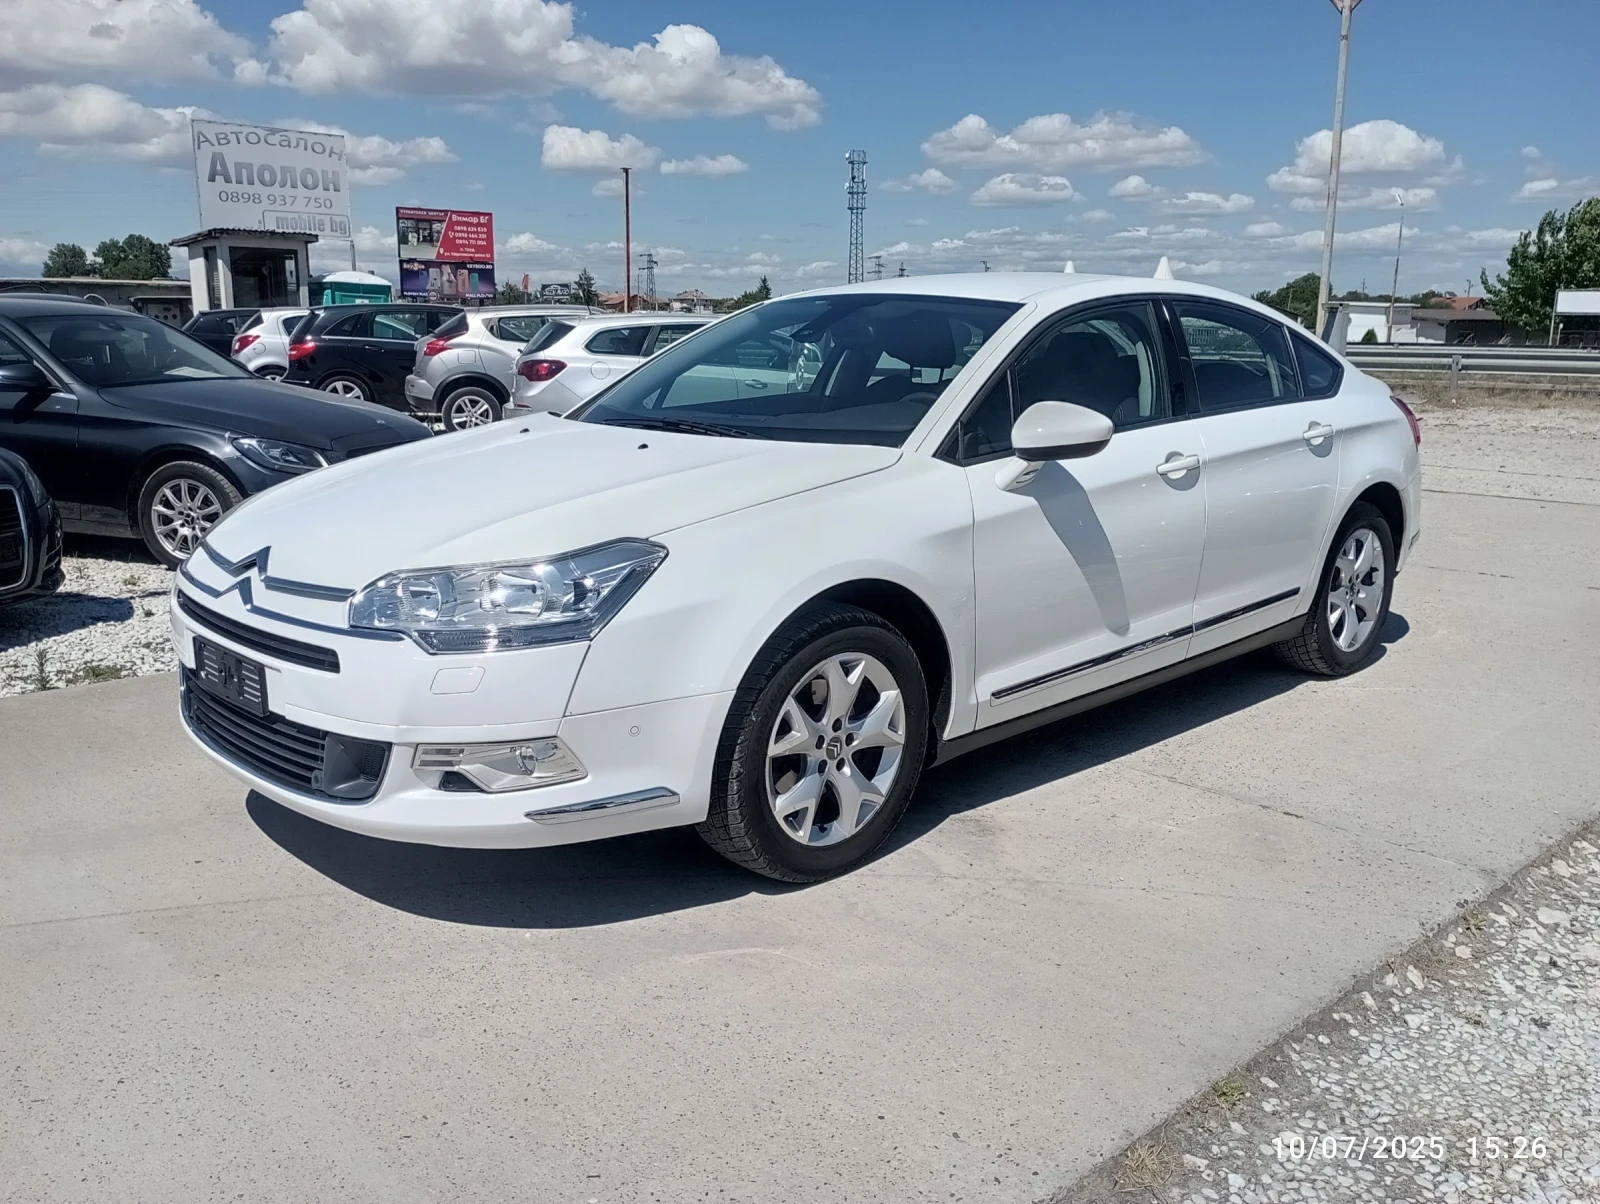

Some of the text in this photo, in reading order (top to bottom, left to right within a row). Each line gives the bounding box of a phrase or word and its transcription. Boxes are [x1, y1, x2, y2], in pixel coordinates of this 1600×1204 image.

[196, 130, 345, 161] Автосалон
[208, 152, 340, 192] Аполон
[218, 190, 333, 209] 0898 937 750
[452, 214, 478, 224] Вимар
